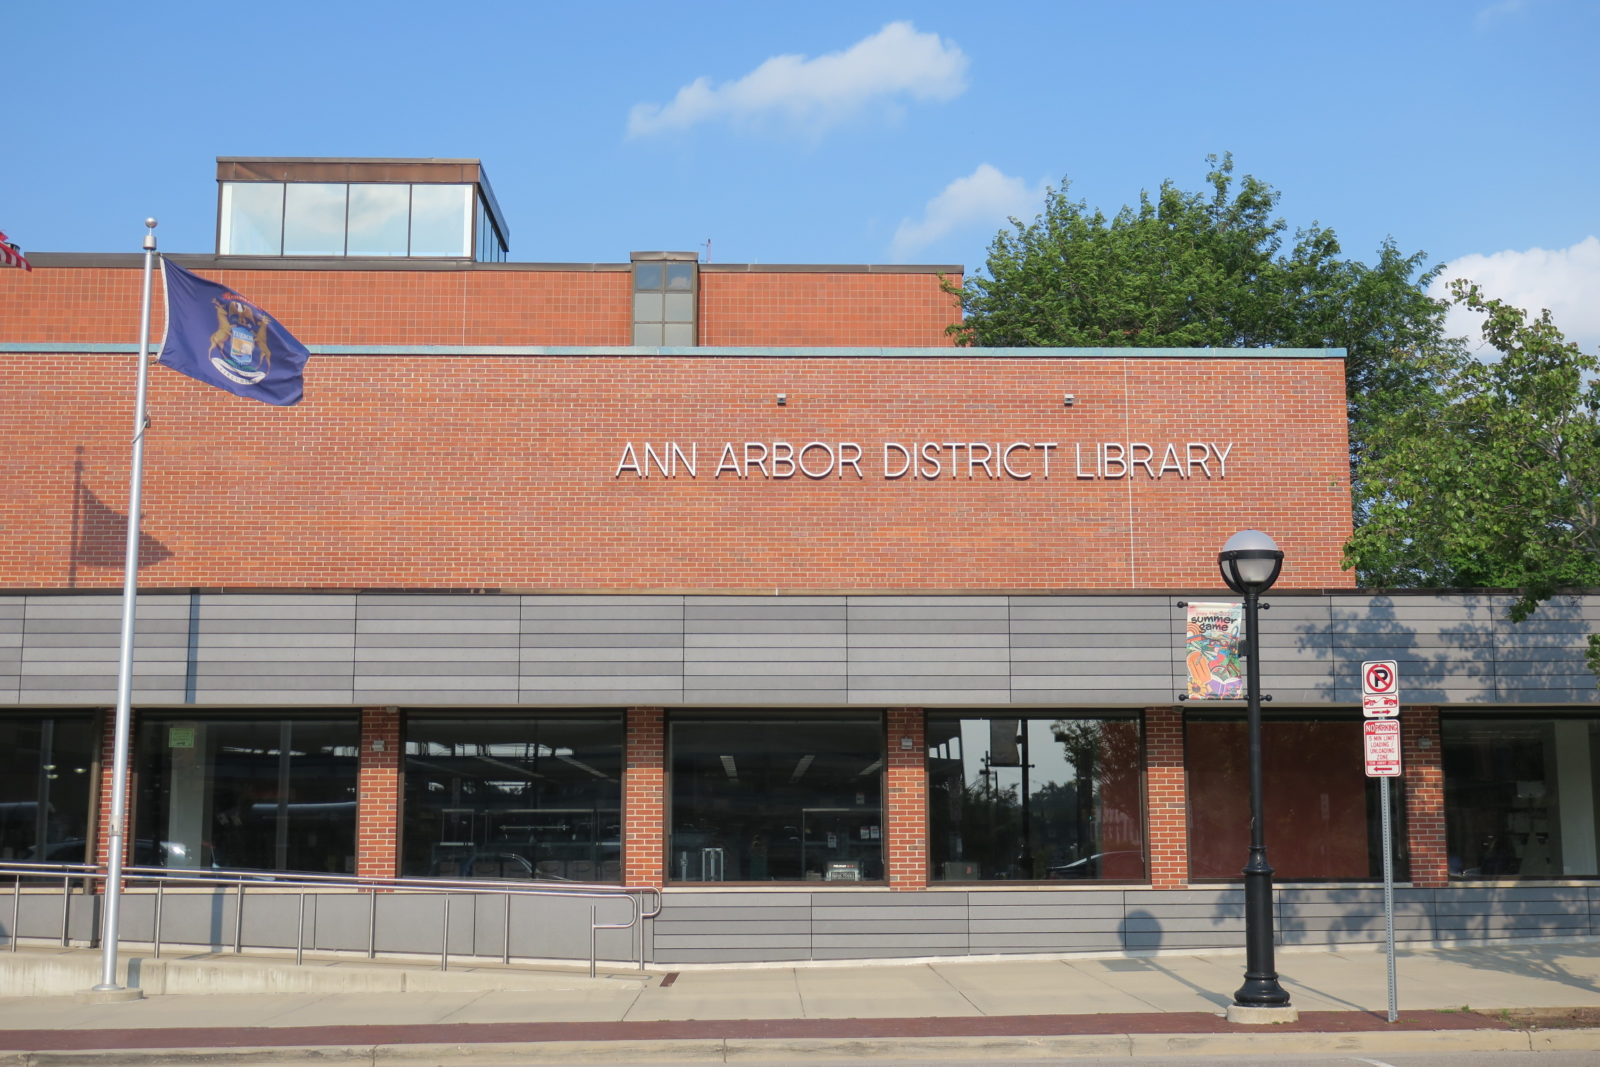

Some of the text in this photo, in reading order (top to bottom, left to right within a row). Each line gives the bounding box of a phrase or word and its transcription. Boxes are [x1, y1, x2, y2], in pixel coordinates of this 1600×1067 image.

[615, 441, 1233, 479] ANN ARBOR DISTRICT LIBRARY
[1191, 615, 1237, 624] summer
[1199, 622, 1228, 633] game
[1366, 724, 1375, 732] NO
